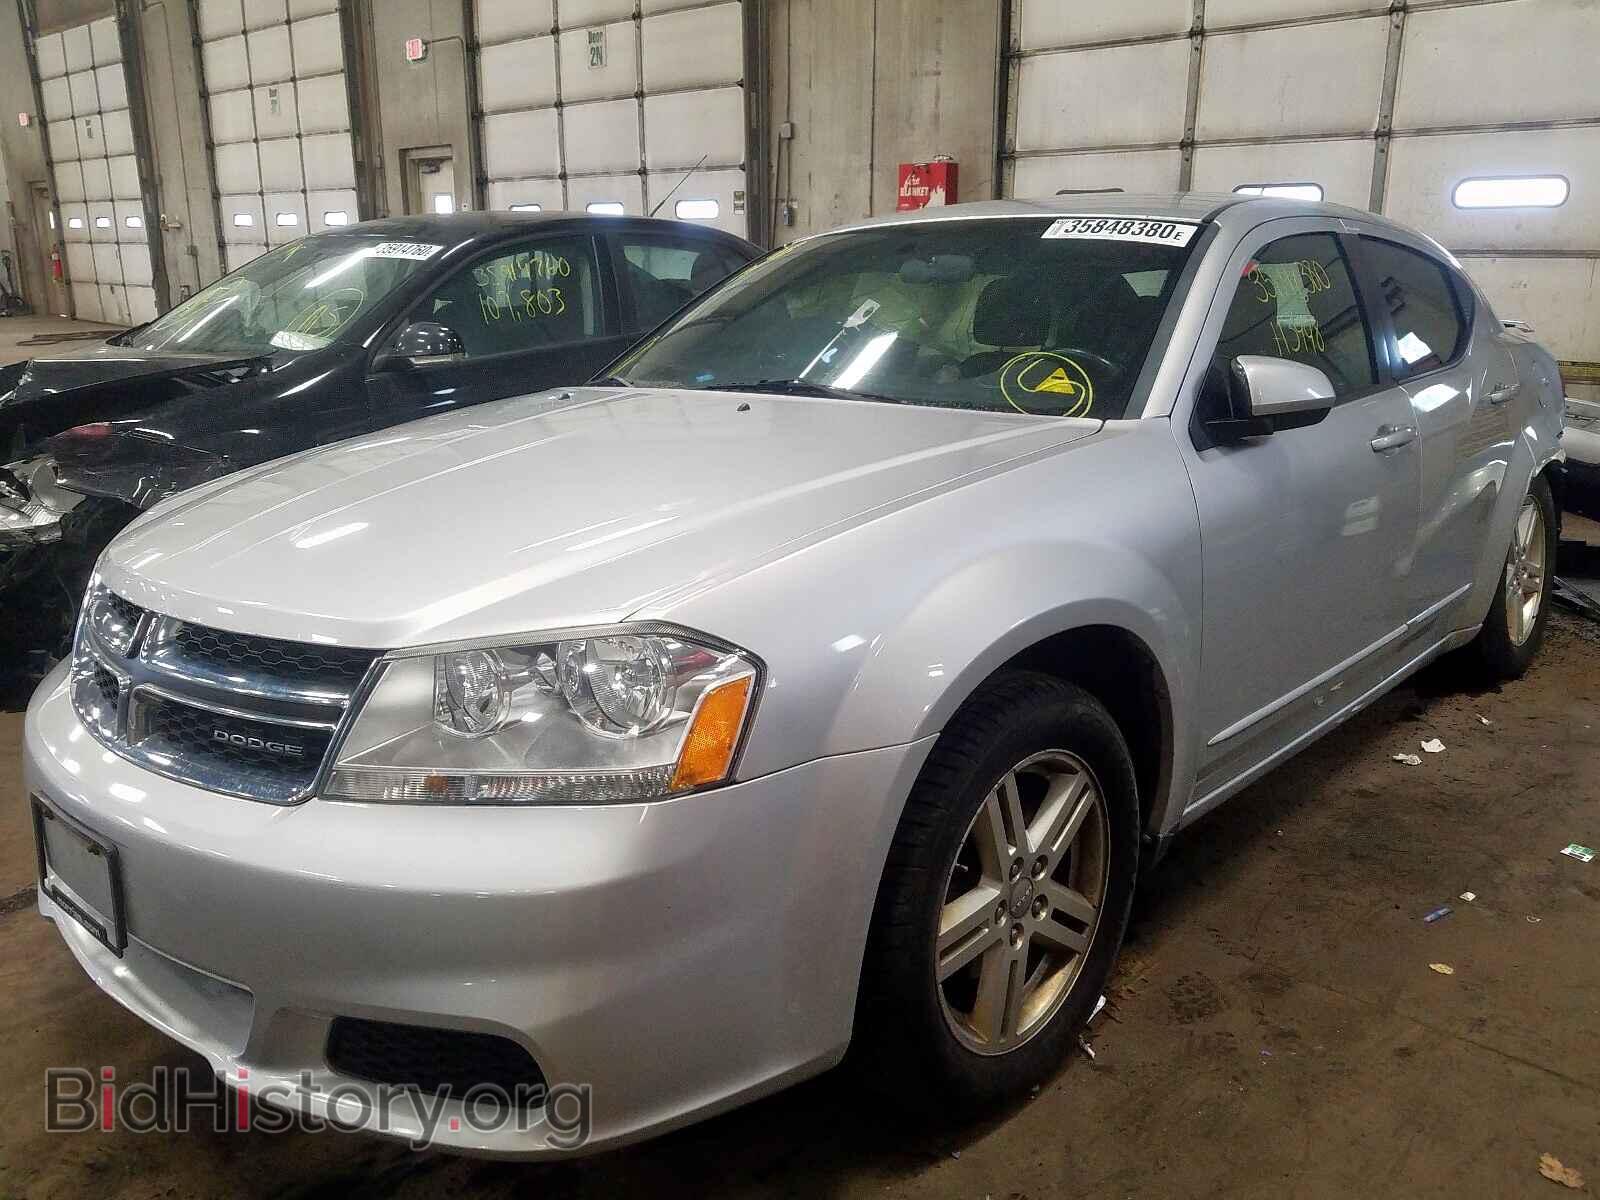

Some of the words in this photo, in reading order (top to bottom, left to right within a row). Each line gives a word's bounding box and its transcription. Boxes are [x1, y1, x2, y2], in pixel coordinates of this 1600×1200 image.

[1064, 219, 1177, 239] 35848380
[1173, 231, 1184, 241] E
[480, 288, 565, 325] 101,803
[213, 729, 305, 757] DODGE
